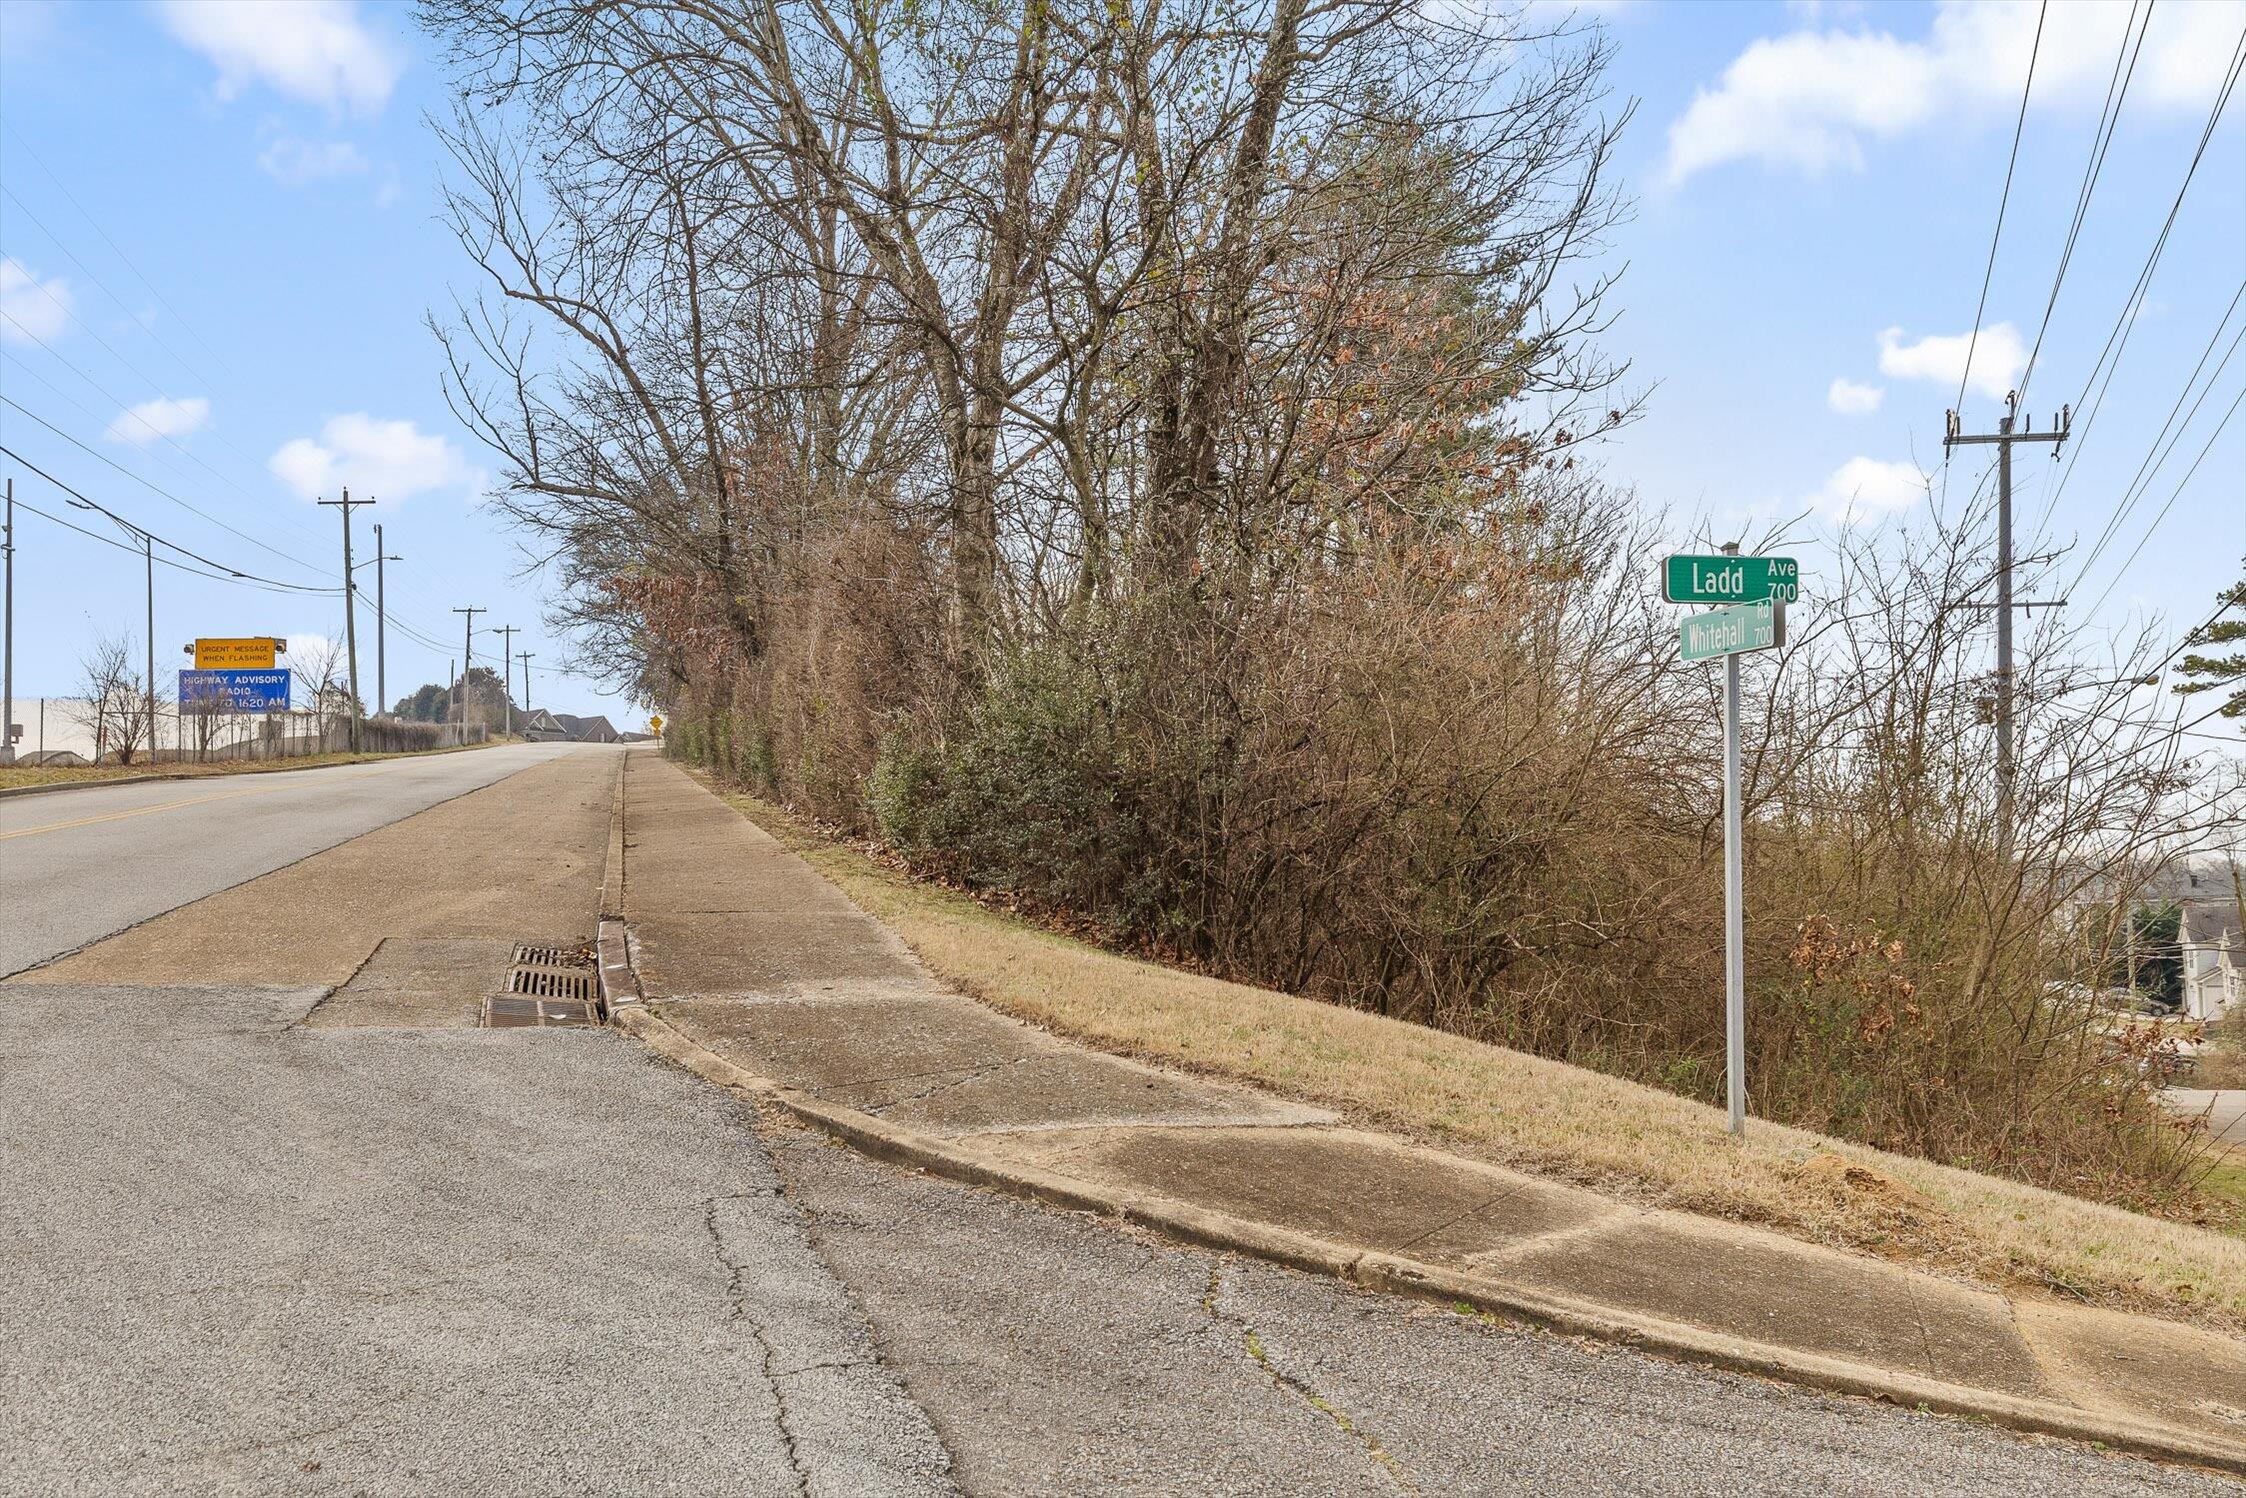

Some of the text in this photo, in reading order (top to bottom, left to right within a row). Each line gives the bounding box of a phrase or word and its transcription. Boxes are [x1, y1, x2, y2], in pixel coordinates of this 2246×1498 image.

[1692, 559, 1796, 594] Ladd Ave
[1767, 583, 1797, 600] 700
[1688, 601, 1769, 654] Whitehall Rd
[1754, 625, 1772, 645] 700
[234, 645, 269, 653] MESSAGE
[203, 654, 268, 662] WHEN FLASHING
[184, 675, 286, 685] HIGHWAY ADVISORY
[238, 698, 264, 708] 1620
[268, 697, 286, 707] AM
